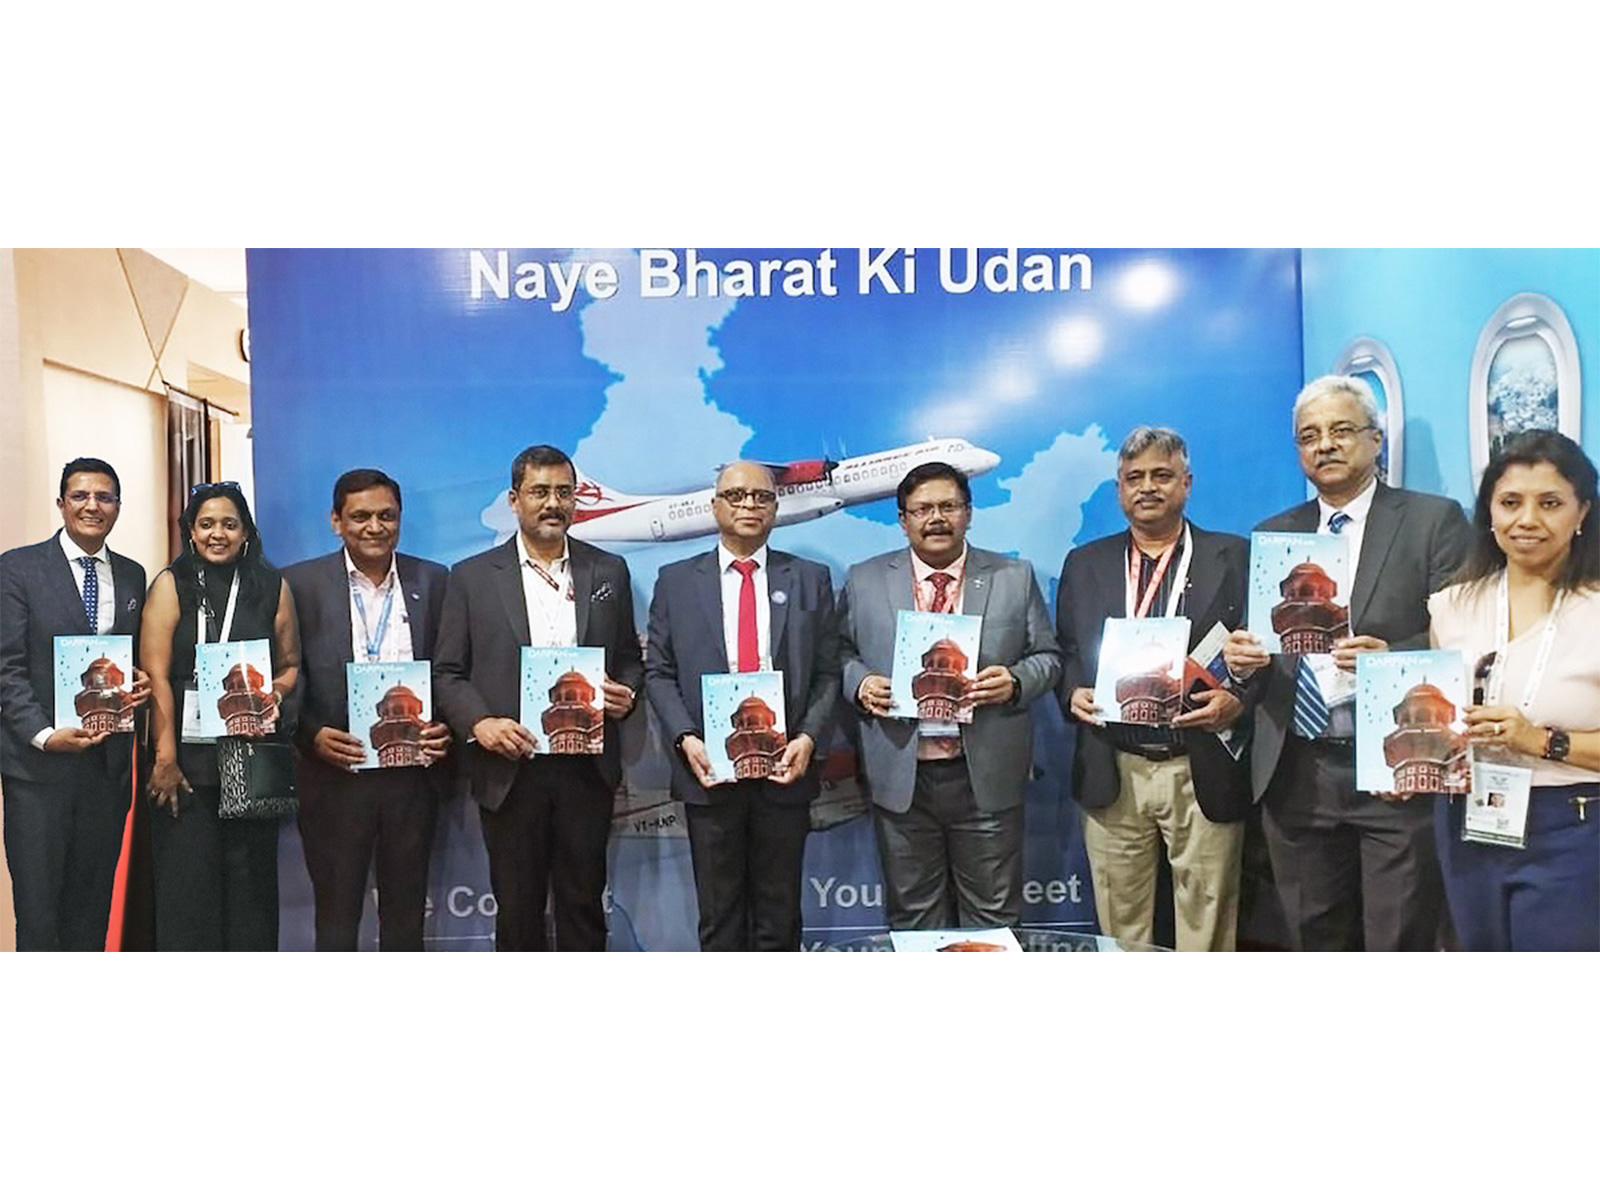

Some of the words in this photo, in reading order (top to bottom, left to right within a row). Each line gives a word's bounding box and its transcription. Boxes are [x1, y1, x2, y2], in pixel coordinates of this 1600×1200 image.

[470, 249, 619, 312] Naye
[640, 248, 838, 298] Bharat
[858, 248, 917, 295] Ki
[939, 248, 1092, 293] Udan
[1021, 873, 1082, 904] eet
